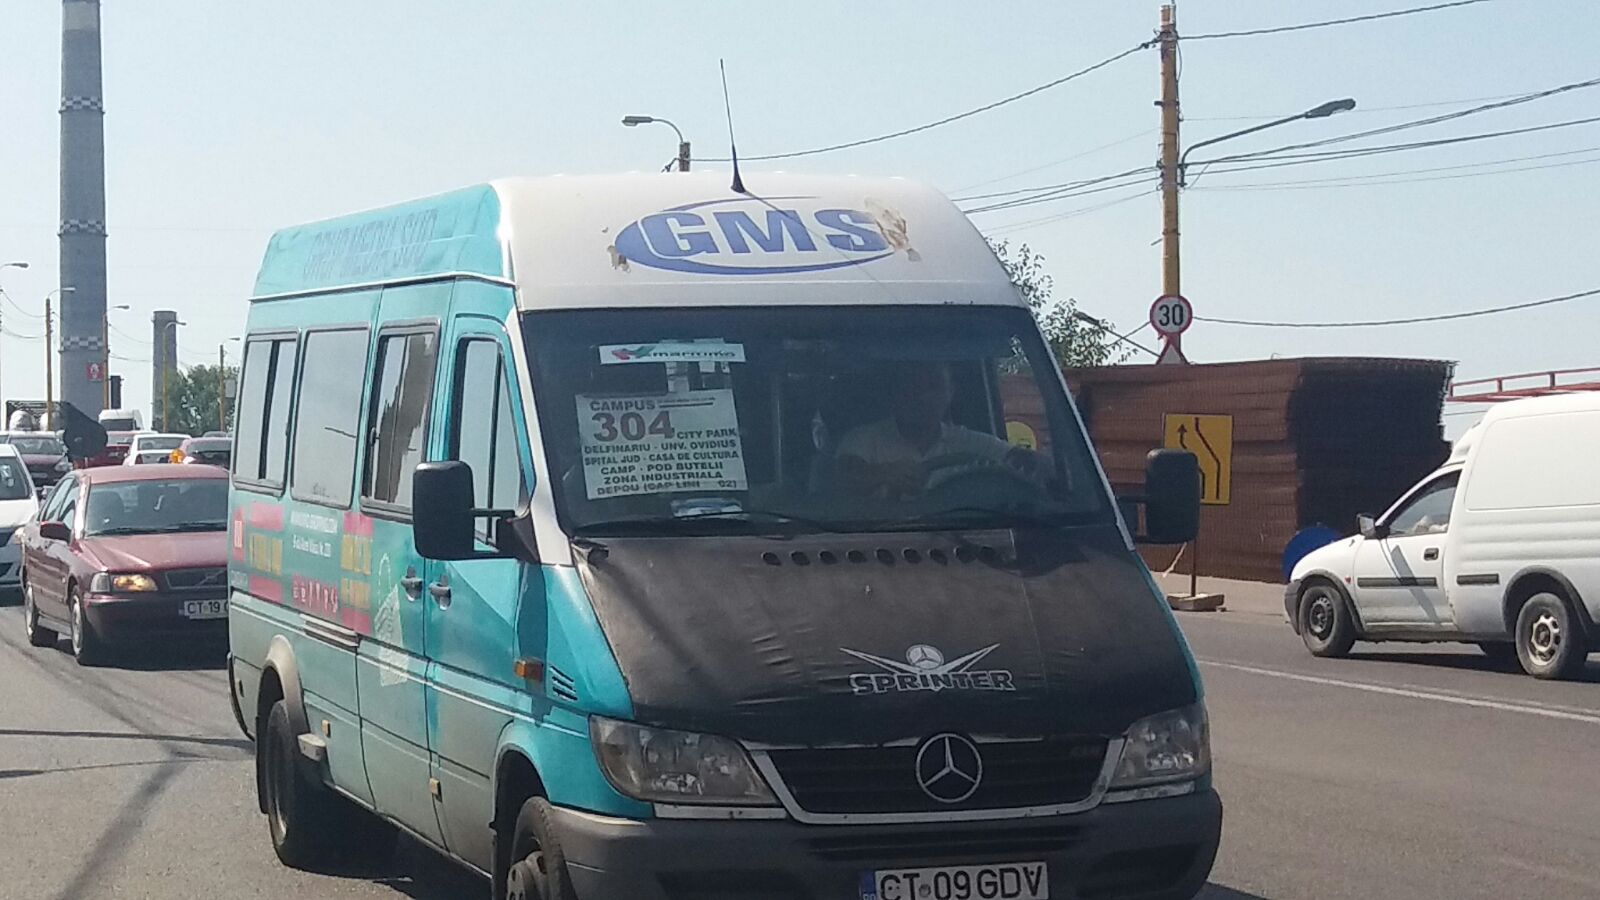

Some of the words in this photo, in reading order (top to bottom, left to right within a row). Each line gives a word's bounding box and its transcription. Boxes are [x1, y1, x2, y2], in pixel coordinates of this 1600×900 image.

[640, 208, 889, 257] GMS
[1159, 304, 1184, 326] 30
[590, 400, 656, 412] CAMPUS
[592, 411, 675, 442] 304
[677, 430, 702, 440] CITY
[706, 428, 737, 438] PARK
[584, 443, 650, 454] DELFINARIU
[690, 439, 737, 450] OVIDIUS
[584, 455, 618, 466] SPITAL
[649, 453, 675, 461] CASA
[677, 452, 690, 461] DE
[692, 451, 740, 460] CULTURA
[601, 465, 636, 475] CAMP
[647, 463, 673, 472] POD
[676, 462, 723, 471] BUTELII
[603, 475, 639, 485] ZONA
[641, 471, 724, 482] INDUSTRIALA
[188, 602, 203, 614] CT
[208, 601, 220, 613] 19
[850, 671, 1017, 695] SPRINTER
